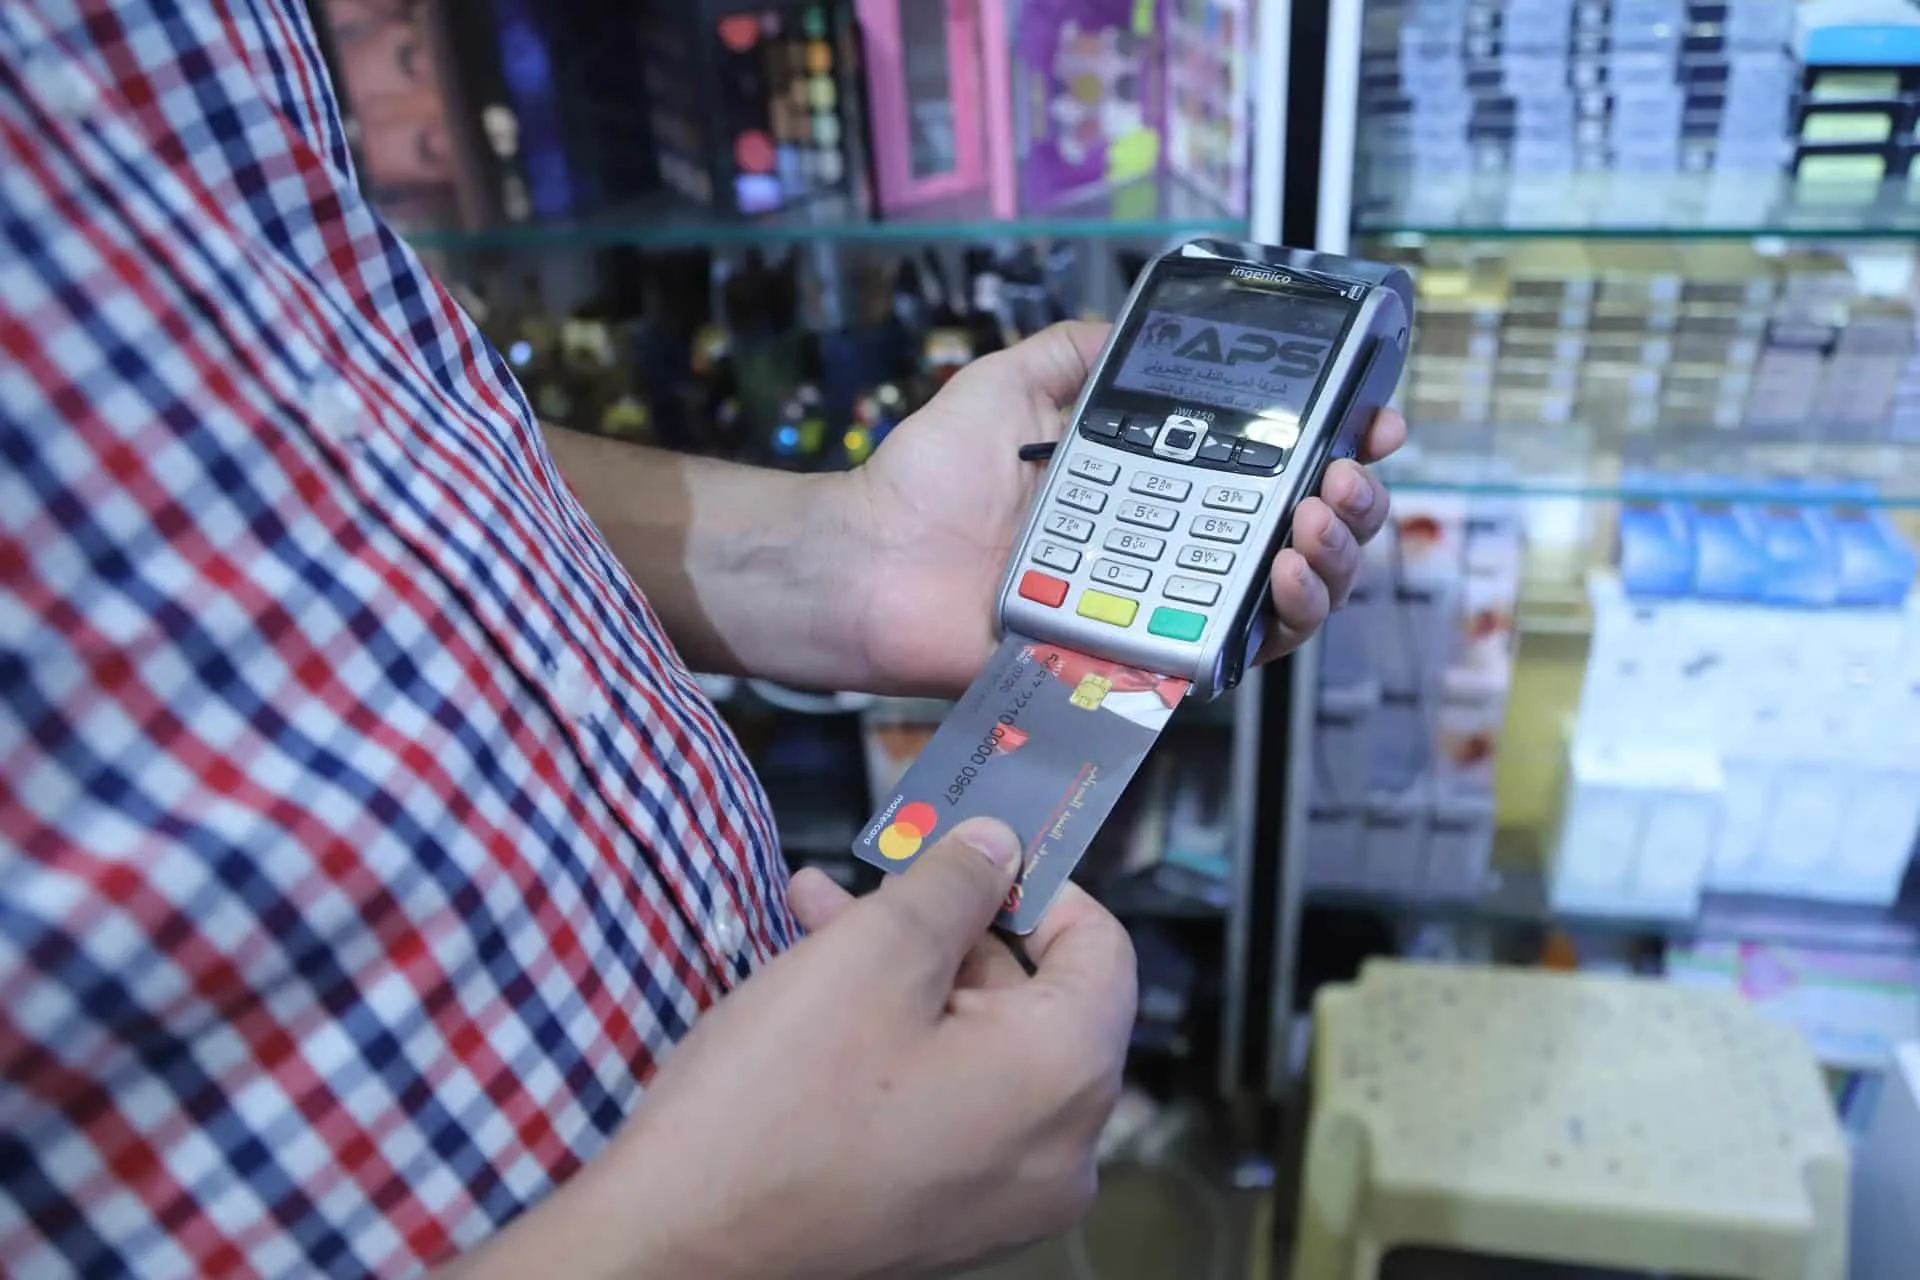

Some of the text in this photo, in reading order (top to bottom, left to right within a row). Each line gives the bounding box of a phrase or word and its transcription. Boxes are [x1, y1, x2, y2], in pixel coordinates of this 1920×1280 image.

[1230, 265, 1292, 284] ingenico
[1172, 326, 1328, 379] APS
[1082, 460, 1091, 472] 1
[1146, 477, 1159, 489] 2
[1066, 488, 1078, 500] 4
[1218, 490, 1230, 502] 3
[1134, 506, 1146, 518] 5
[1056, 517, 1067, 529] 7
[1204, 520, 1217, 532] 6
[1120, 535, 1132, 548] 8
[1043, 546, 1055, 558] F
[1191, 550, 1203, 562] 9
[1108, 566, 1120, 578] 0
[970, 727, 1005, 765] 0000
[944, 766, 977, 806] 0967
[863, 793, 904, 846] mastercard
